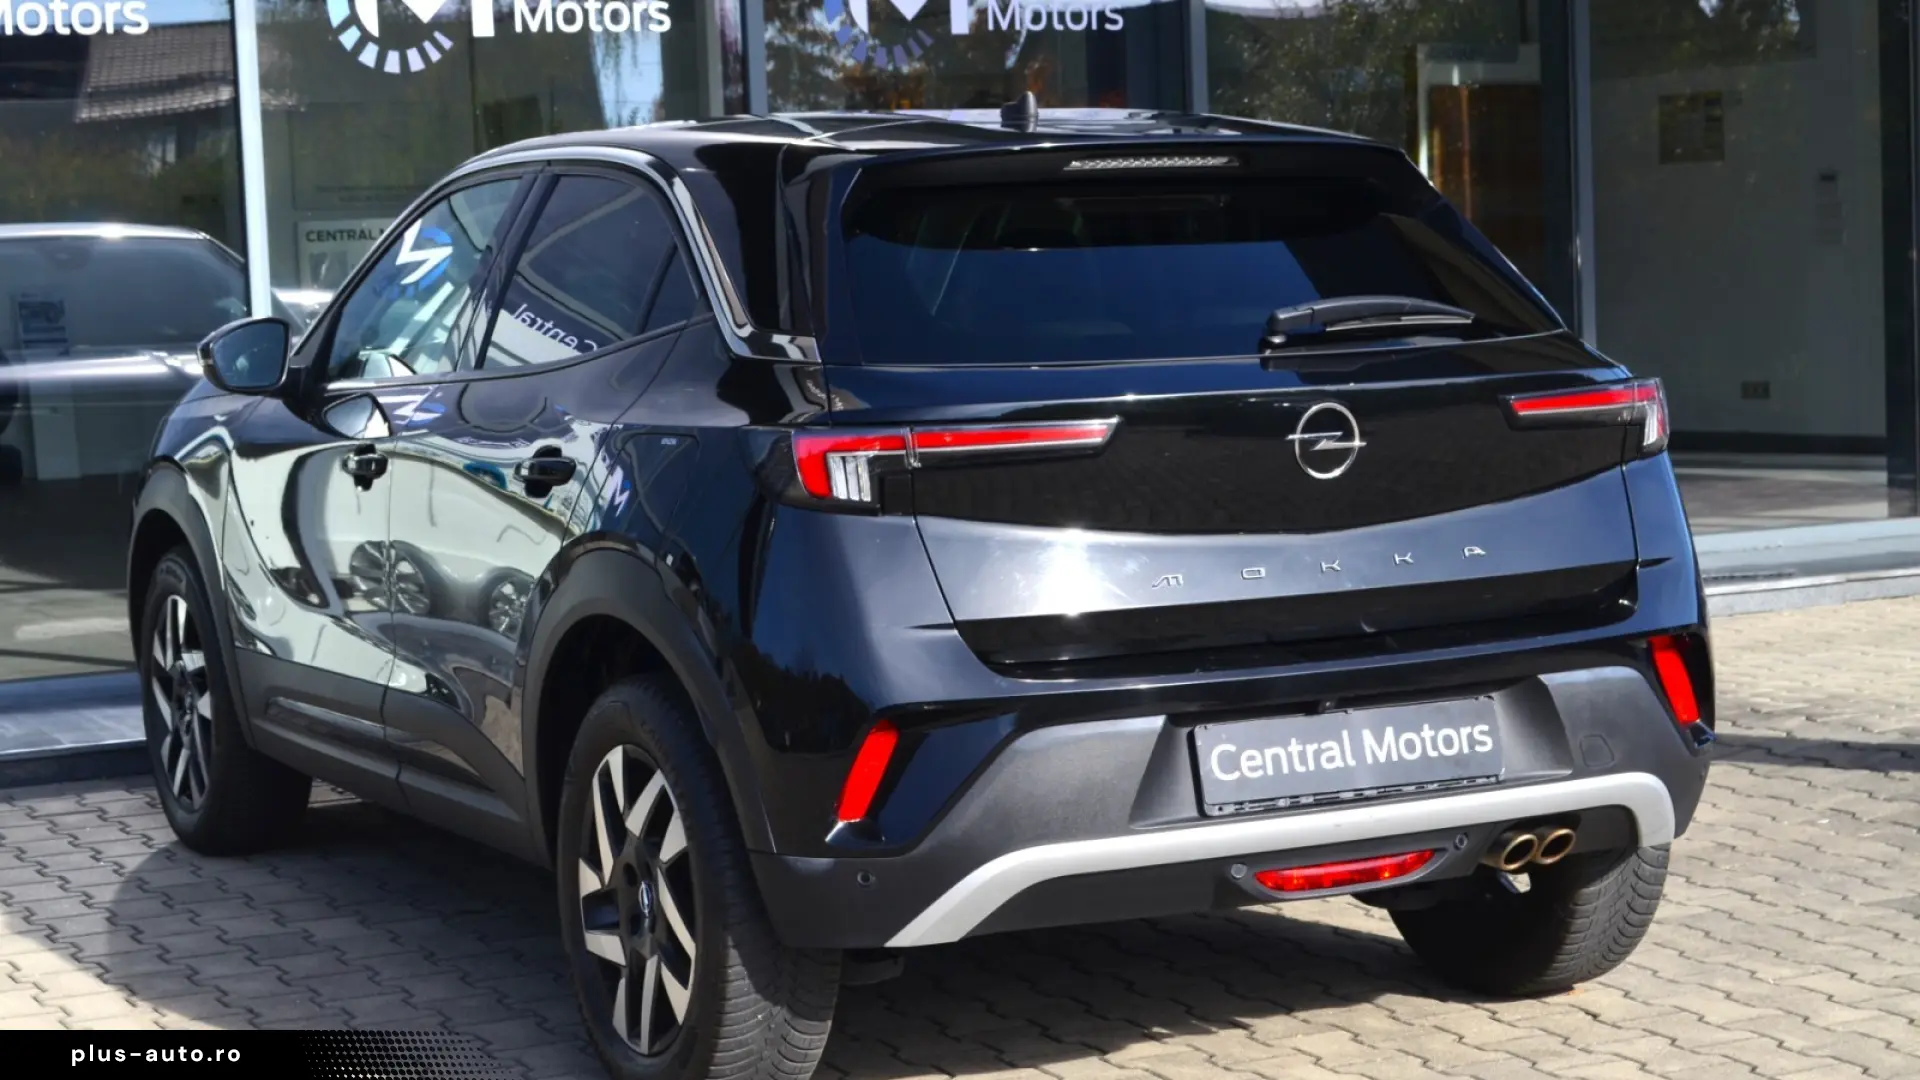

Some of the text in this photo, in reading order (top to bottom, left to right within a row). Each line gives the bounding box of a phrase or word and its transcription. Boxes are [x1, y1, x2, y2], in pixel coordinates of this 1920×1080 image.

[513, 0, 672, 33] Motors
[987, 0, 1124, 32] Motors
[305, 228, 377, 242] CENTRAL
[1210, 723, 1493, 781] Central Motors
